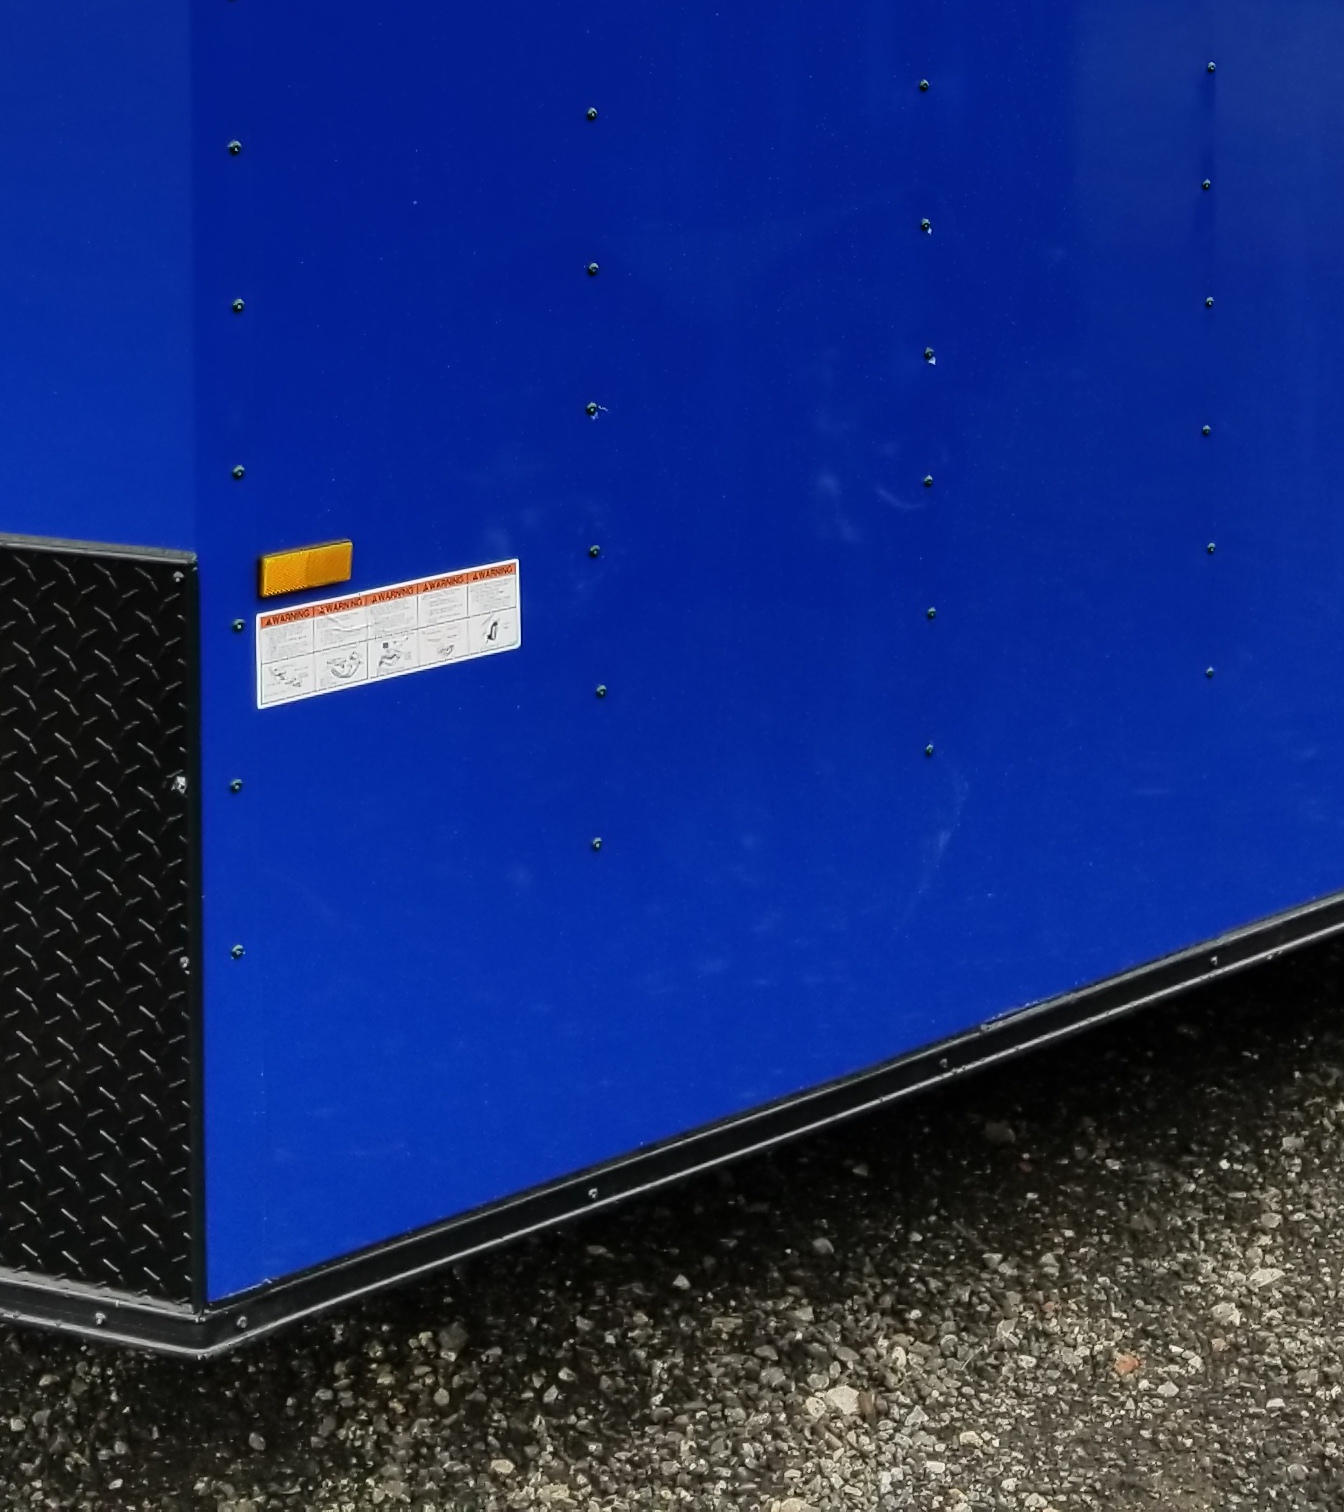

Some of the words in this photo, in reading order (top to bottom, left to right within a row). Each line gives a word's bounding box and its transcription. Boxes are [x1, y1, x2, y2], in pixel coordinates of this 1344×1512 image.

[479, 565, 513, 579] WARNING
[430, 575, 464, 590] WARNING
[378, 586, 414, 601] WARNING
[325, 597, 363, 612] WARNING
[272, 609, 310, 624] WARNING
